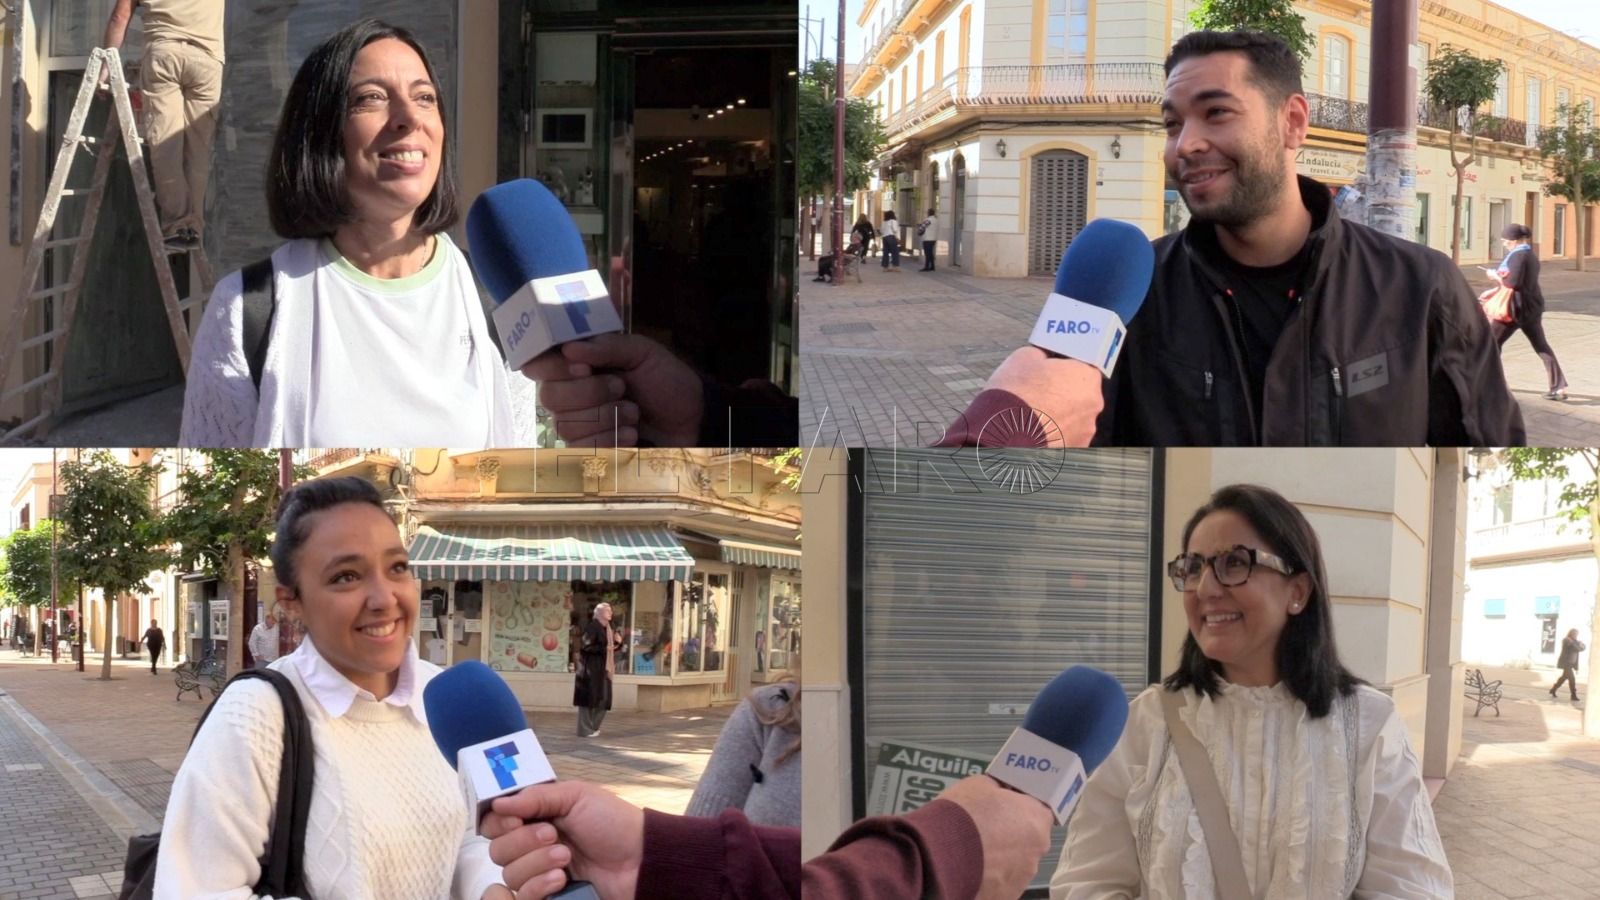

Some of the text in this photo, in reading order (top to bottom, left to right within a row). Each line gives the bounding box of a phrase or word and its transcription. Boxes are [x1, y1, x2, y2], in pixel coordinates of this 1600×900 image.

[507, 311, 530, 352] FARO
[1046, 320, 1091, 334] FARO
[890, 748, 983, 776] Alquila
[1006, 753, 1051, 772] FARO
